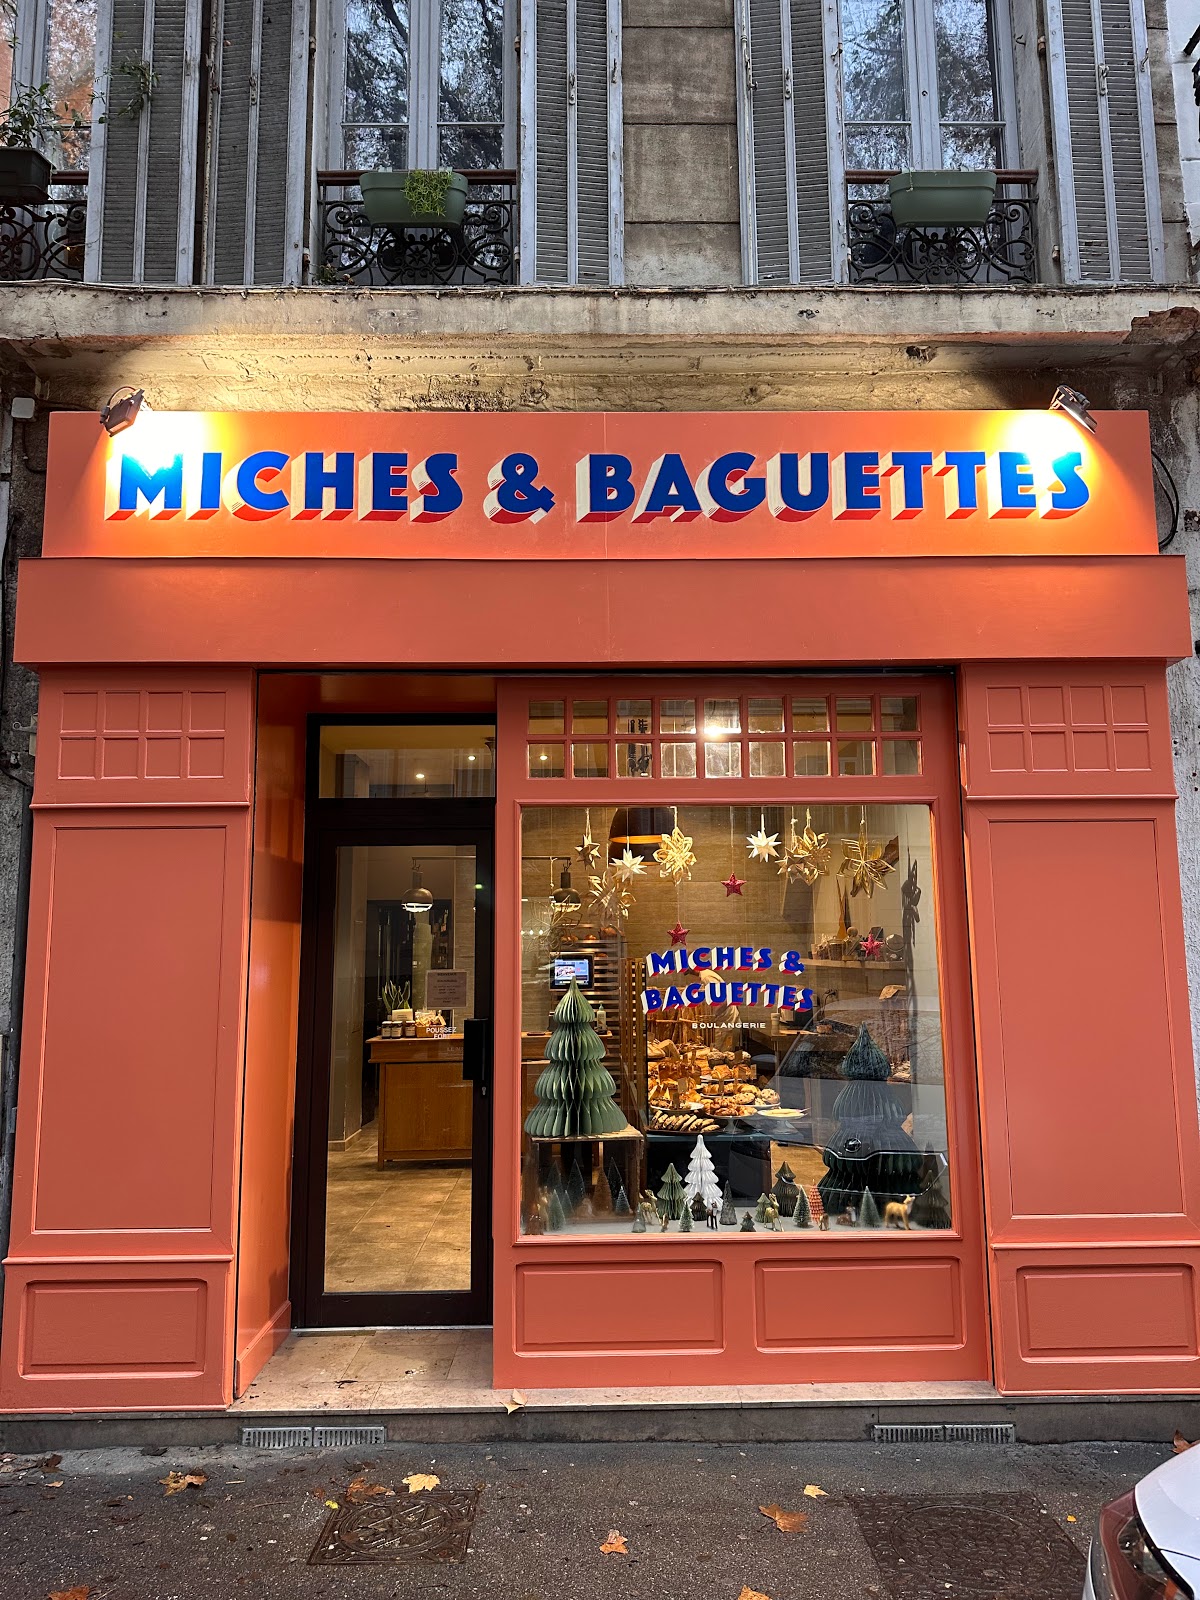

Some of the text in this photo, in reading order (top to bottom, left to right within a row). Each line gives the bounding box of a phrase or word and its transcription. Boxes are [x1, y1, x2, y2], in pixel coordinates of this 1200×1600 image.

[104, 450, 1092, 524] MICHES & BAGUETTES
[646, 946, 804, 977] MICHES &
[640, 982, 814, 1015] BAGUETTES
